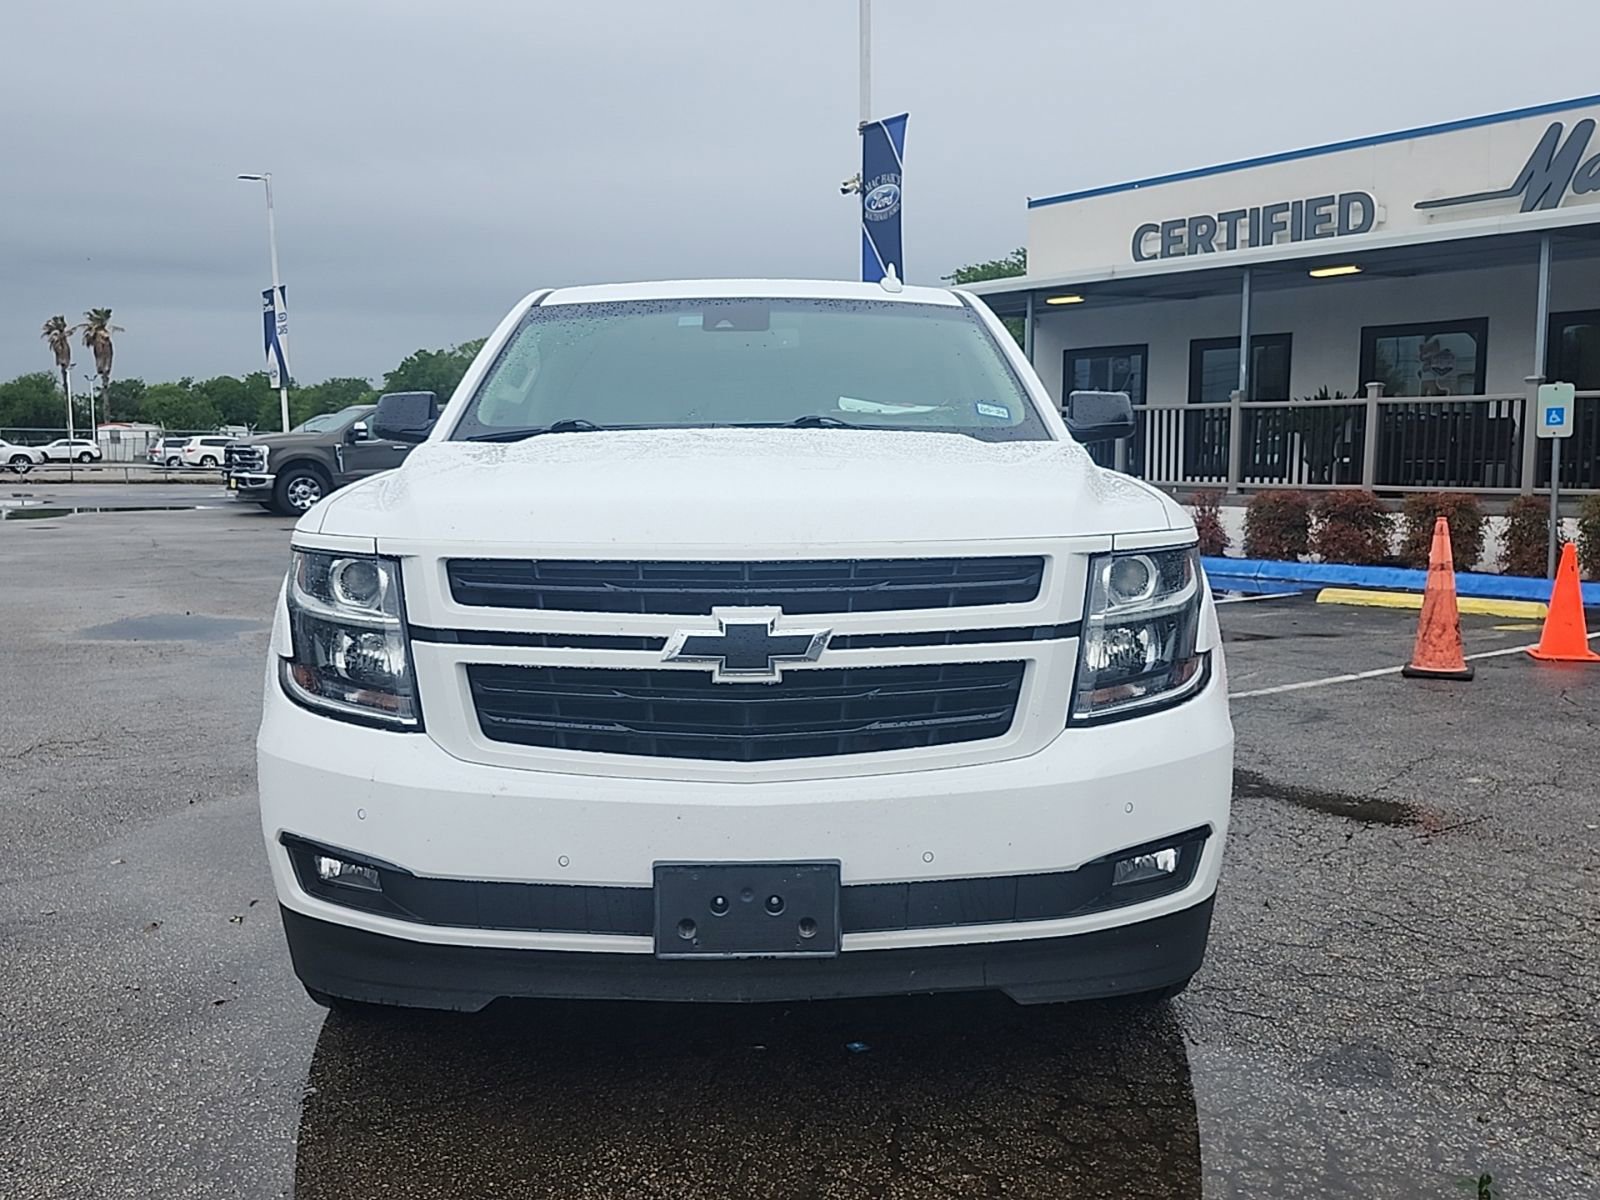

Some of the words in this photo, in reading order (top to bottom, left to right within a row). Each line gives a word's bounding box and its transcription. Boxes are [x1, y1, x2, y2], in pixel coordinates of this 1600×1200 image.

[865, 175, 881, 192] MAC
[871, 190, 895, 210] Ford
[1132, 191, 1375, 262] CERTIFIED
